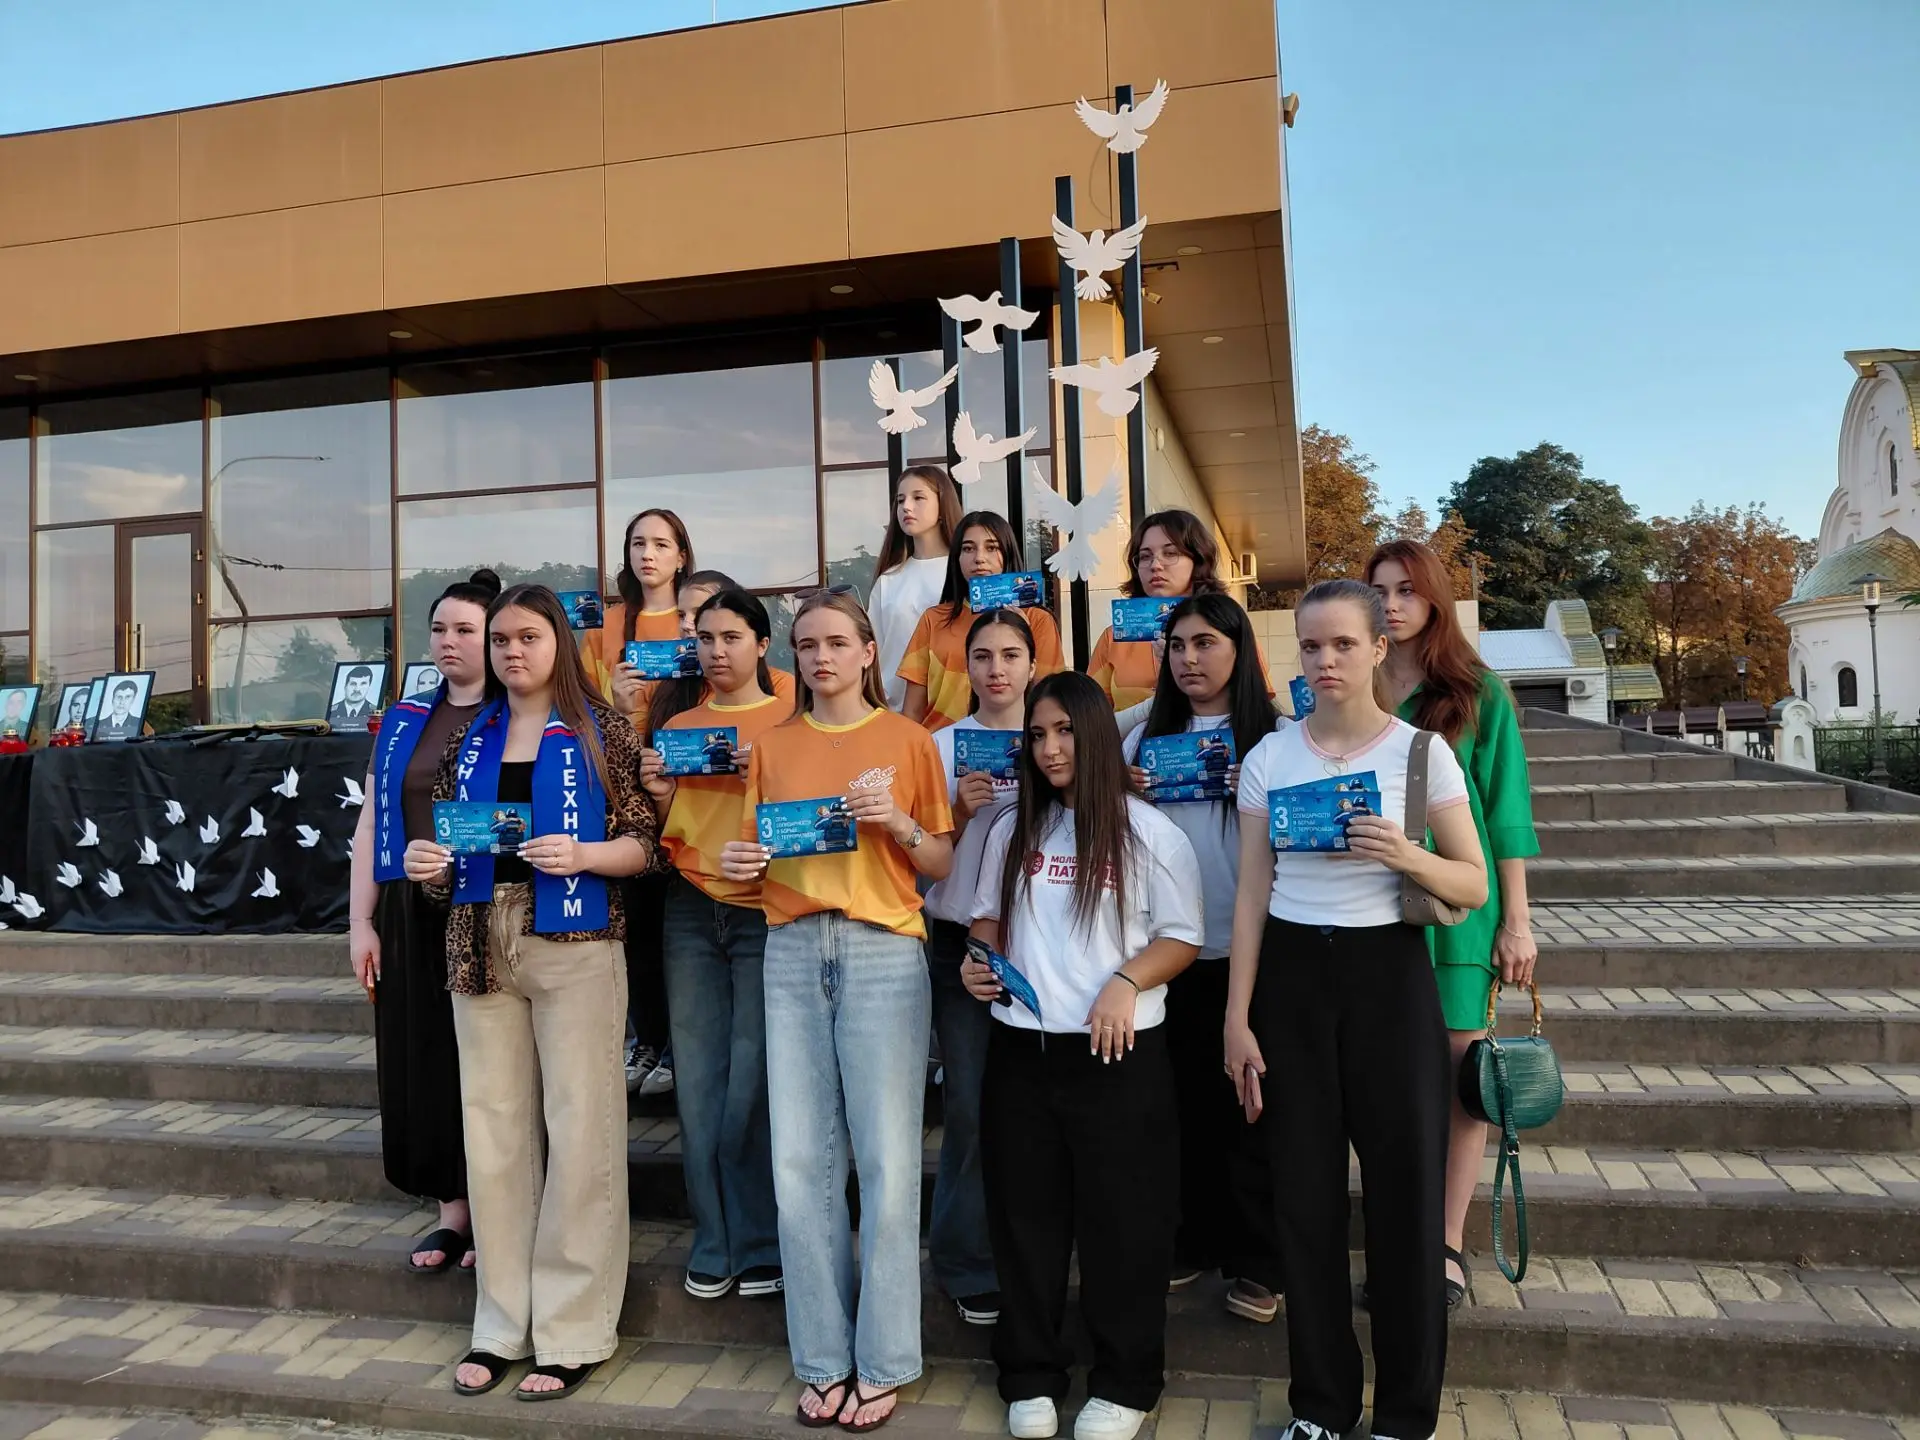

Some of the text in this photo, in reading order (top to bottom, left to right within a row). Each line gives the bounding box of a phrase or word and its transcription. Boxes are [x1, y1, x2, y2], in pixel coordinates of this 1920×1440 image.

[971, 586, 981, 600] 3
[1114, 608, 1124, 625] 3
[628, 649, 639, 666] 3
[1301, 686, 1314, 707] 3
[656, 741, 666, 759] 3
[956, 740, 968, 760] 3
[1145, 749, 1157, 769] 3
[381, 721, 408, 867] ТЕХНИКУМ
[438, 817, 451, 837] 3
[1274, 806, 1289, 829] 3
[561, 748, 582, 917] ТЕХНУМ
[761, 817, 773, 839] 3
